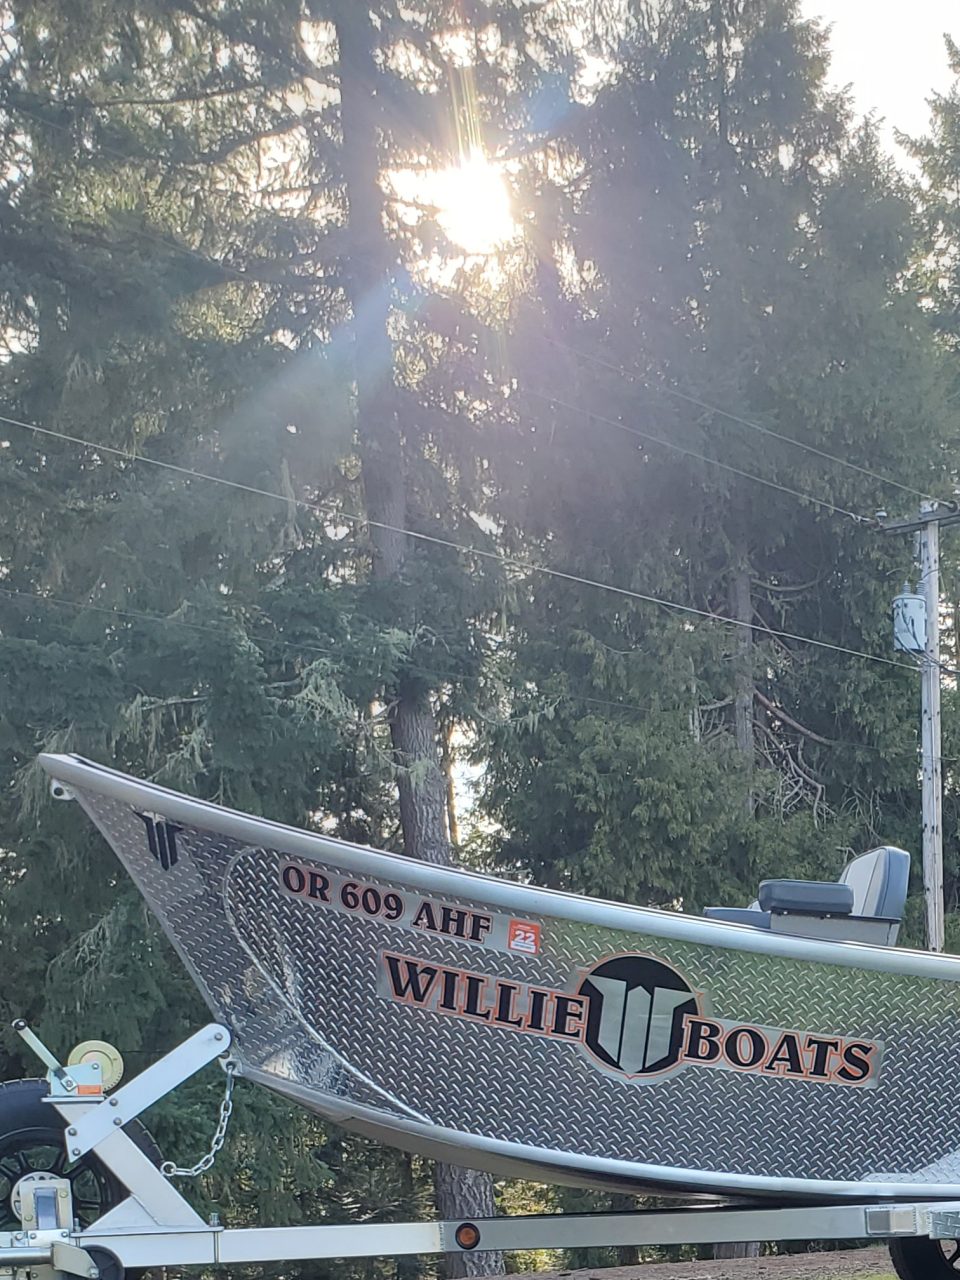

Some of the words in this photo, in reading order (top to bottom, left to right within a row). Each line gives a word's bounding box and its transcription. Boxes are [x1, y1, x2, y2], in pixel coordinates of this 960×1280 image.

[282, 865, 331, 902] OR
[340, 882, 404, 920] 609
[412, 902, 491, 942] AHF
[514, 930, 536, 946] 22
[385, 955, 585, 1039] WILLIE
[684, 1019, 875, 1082] BOATS
